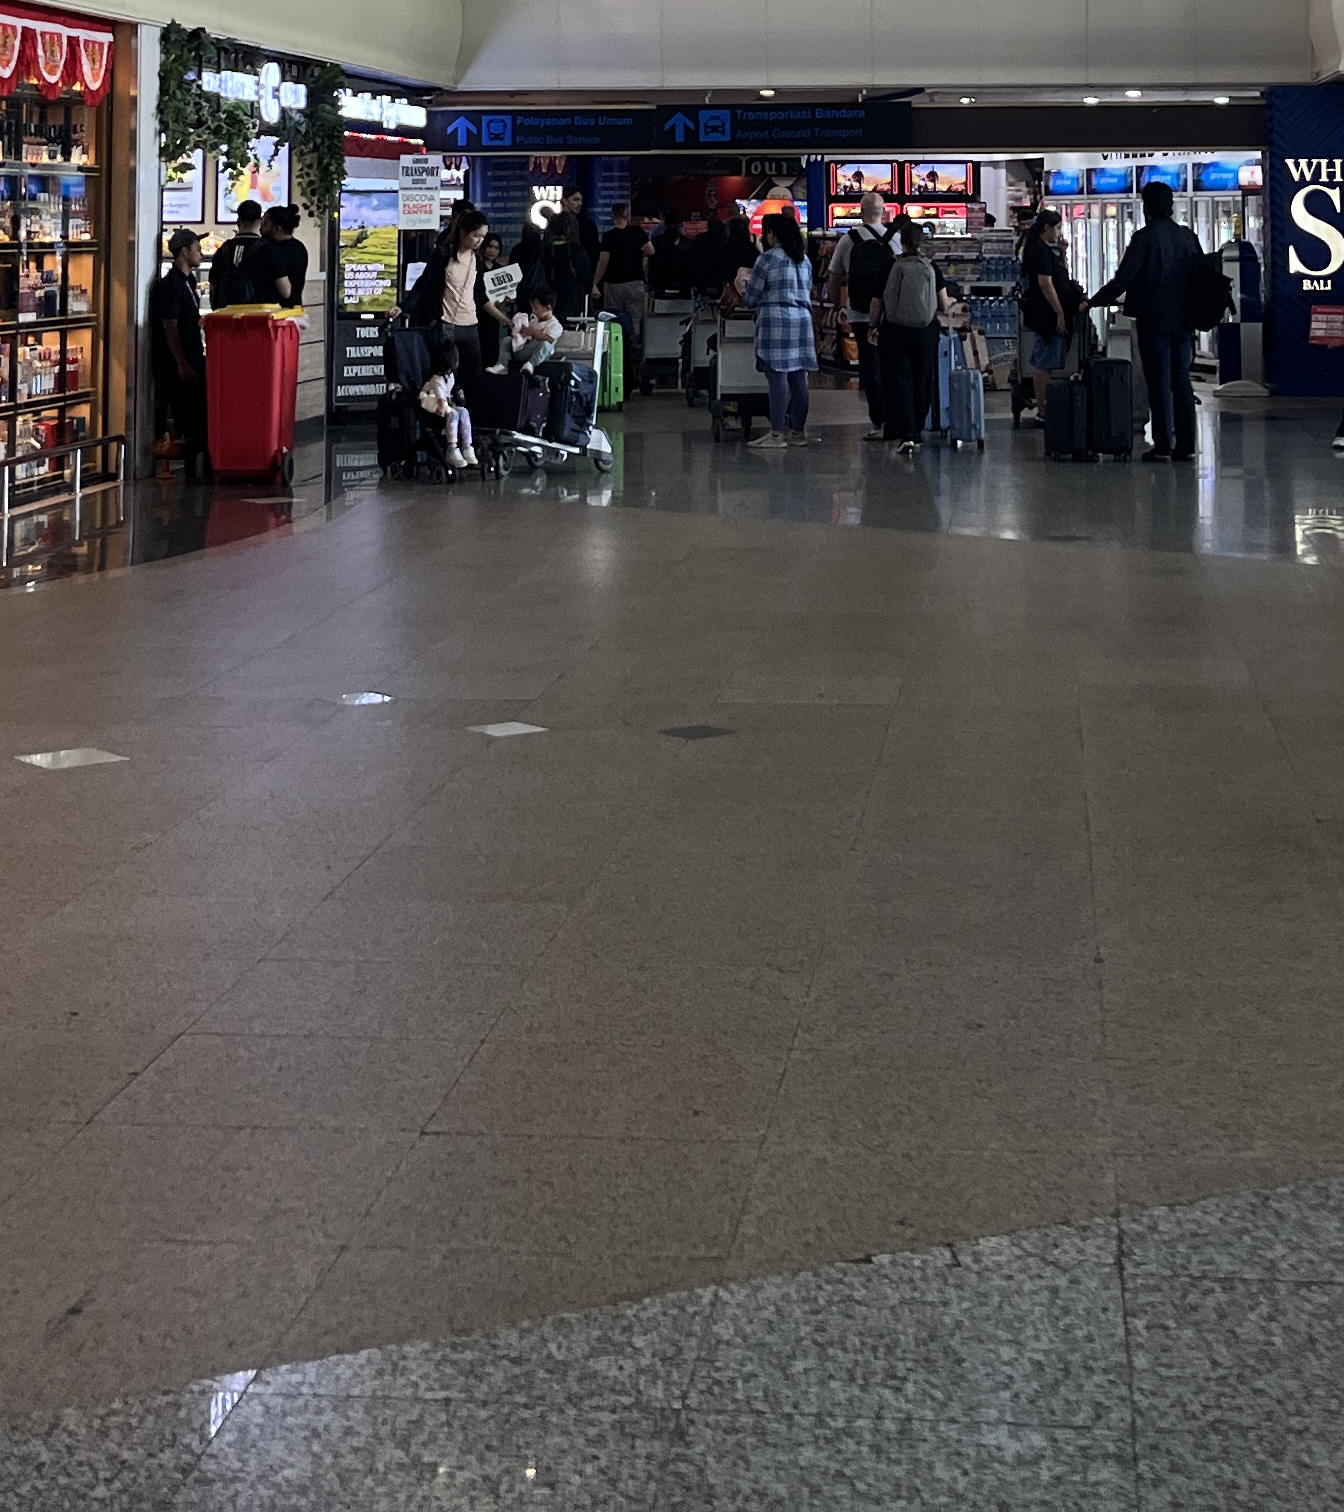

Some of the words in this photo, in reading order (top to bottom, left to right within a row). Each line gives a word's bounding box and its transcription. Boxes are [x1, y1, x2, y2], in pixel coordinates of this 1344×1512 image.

[516, 116, 571, 128] Pelayanan
[574, 116, 595, 126] Bus
[598, 115, 633, 126] Umum
[735, 109, 812, 122] Transportasi
[815, 108, 866, 119] Bandara
[516, 135, 544, 144] Public
[546, 135, 564, 144] Bus
[566, 135, 601, 145] Service
[735, 129, 769, 141] Airport
[771, 128, 811, 139] Ground
[814, 127, 863, 140] Transport
[401, 166, 439, 177] TRANSPORT
[1285, 158, 1344, 182] WH
[532, 186, 564, 200] WH
[1302, 279, 1332, 291] BALI
[356, 326, 379, 338] TOURS
[346, 346, 384, 358] TRANSPOR
[343, 364, 385, 377] EXPERIENC
[336, 383, 387, 397] ACCOMMODATI
